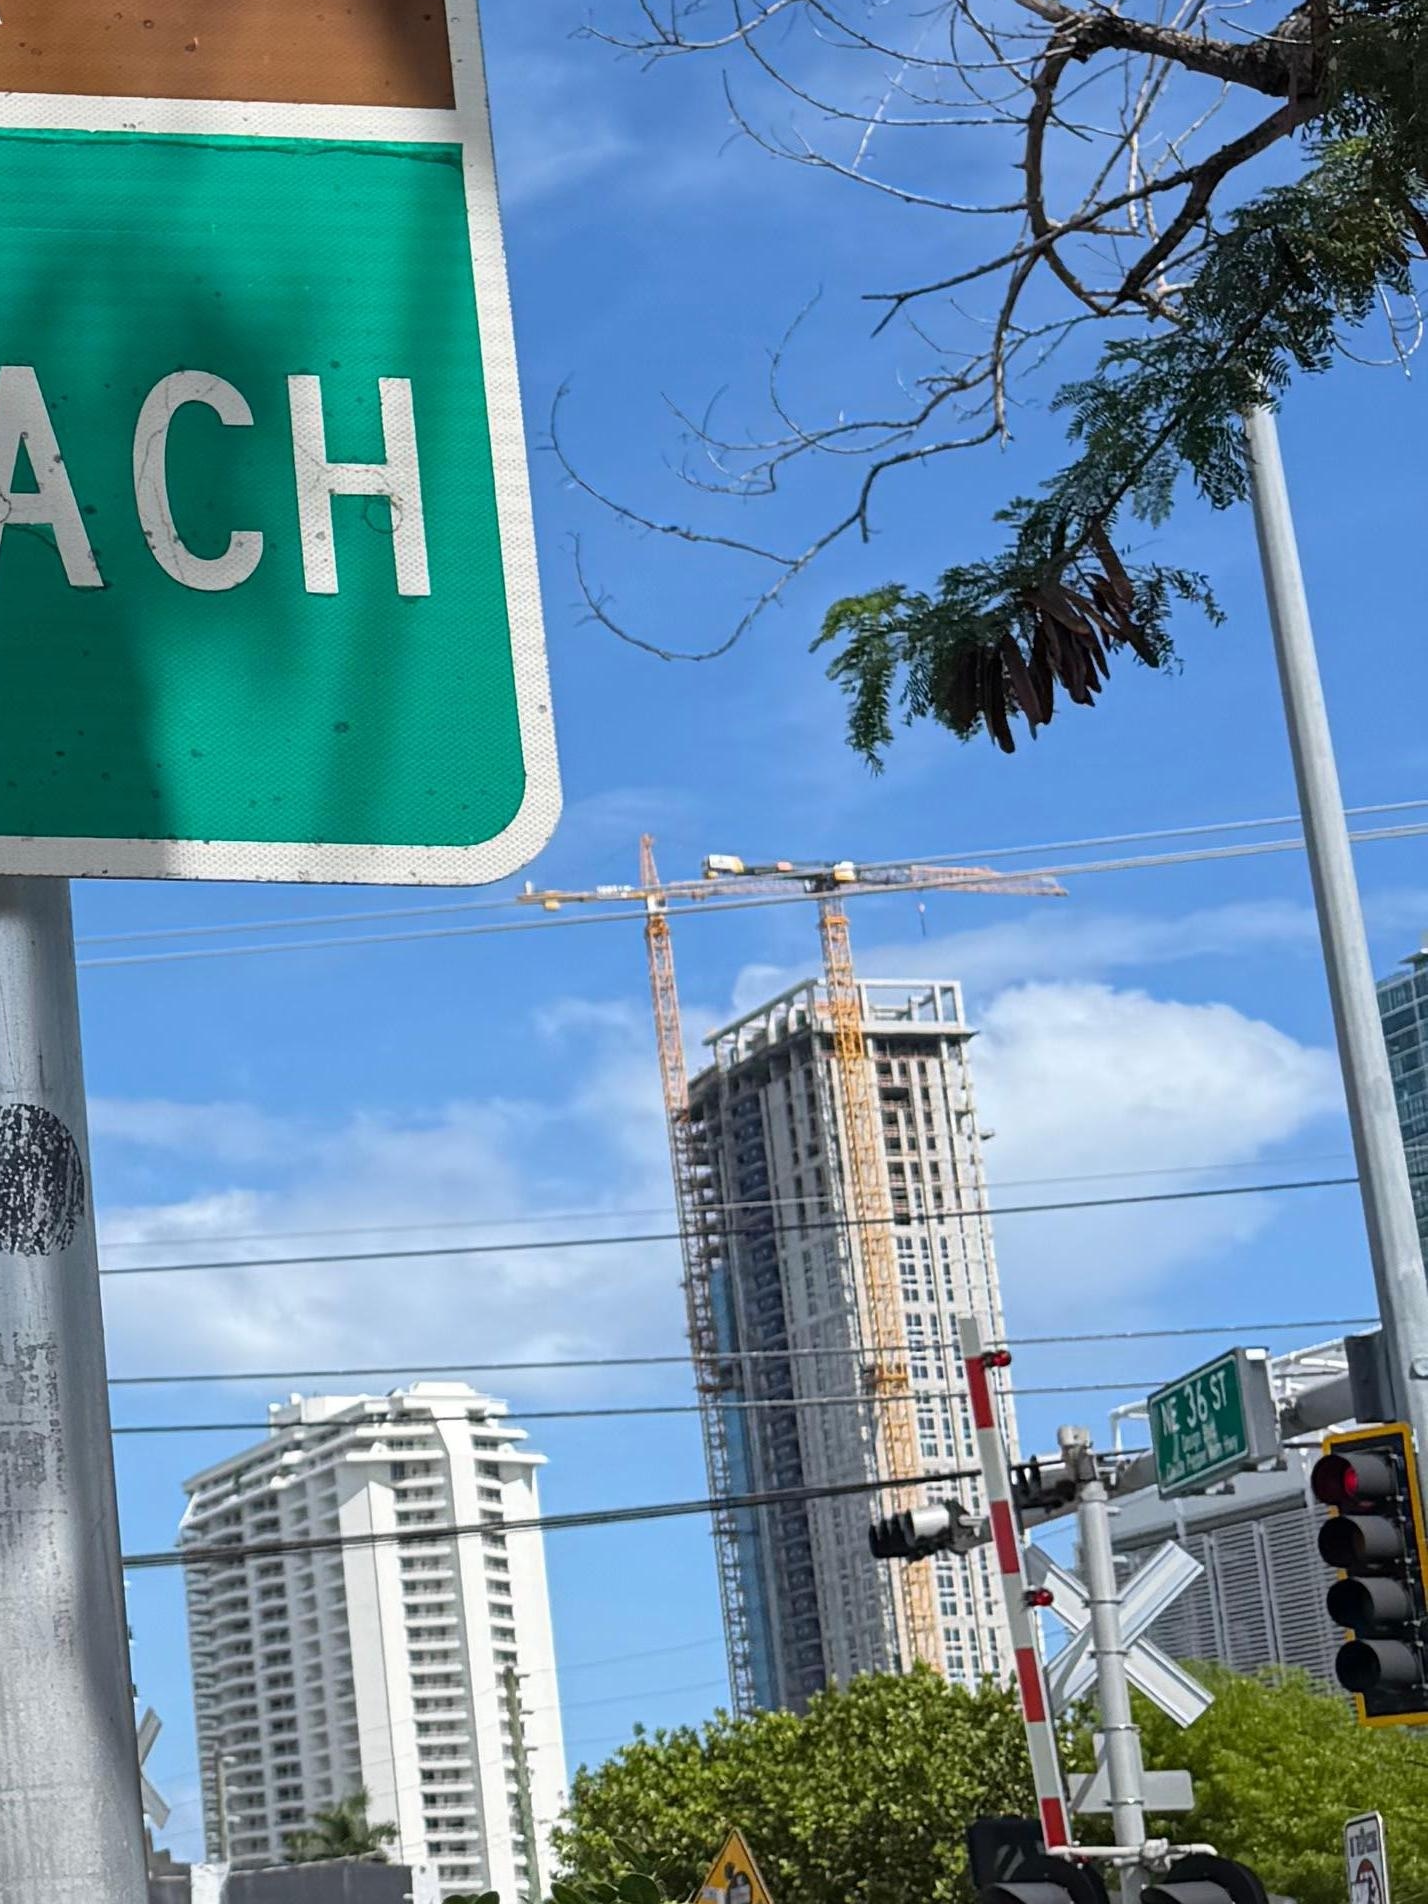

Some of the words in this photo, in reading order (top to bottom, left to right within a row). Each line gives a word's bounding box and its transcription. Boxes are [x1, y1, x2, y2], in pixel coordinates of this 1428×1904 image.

[1160, 1396, 1180, 1437] NE
[1184, 1380, 1208, 1429] 36
[1209, 1369, 1227, 1411] ST
